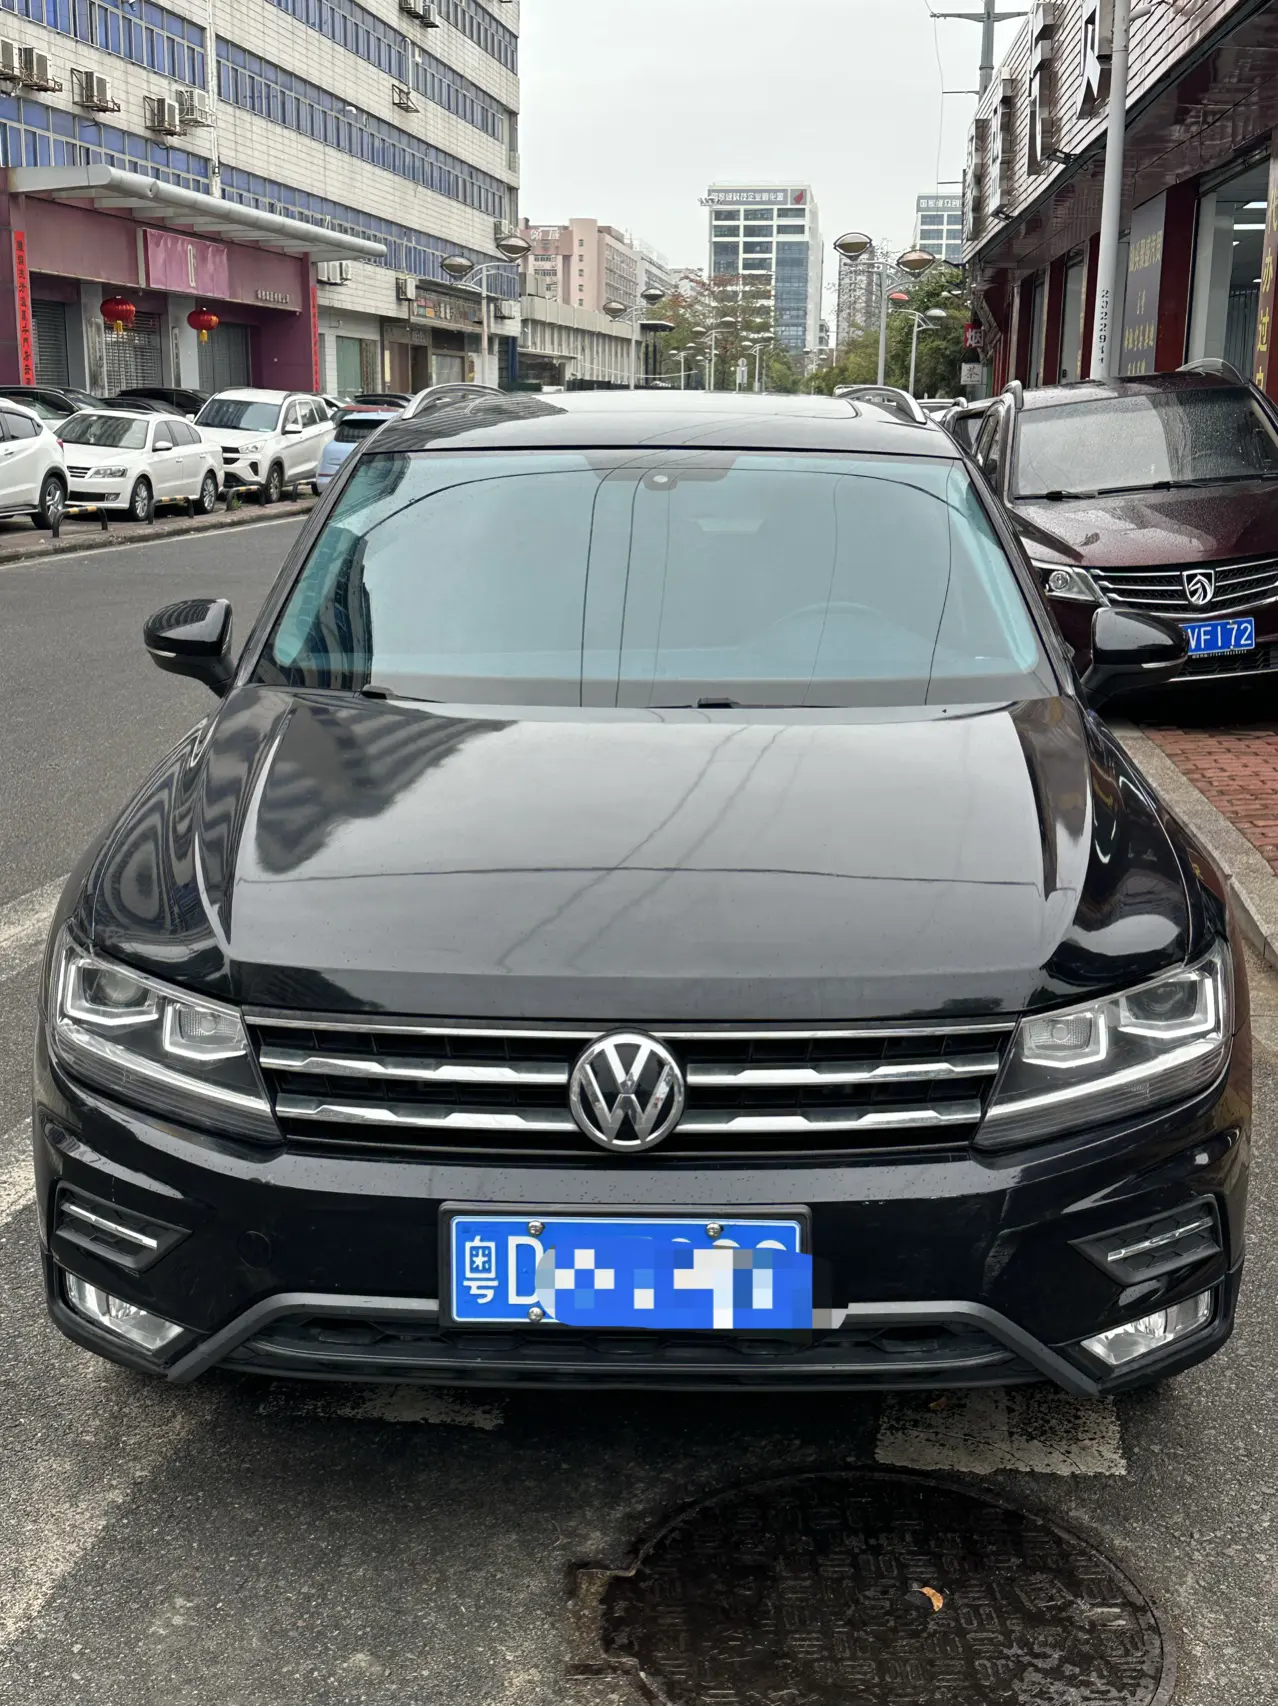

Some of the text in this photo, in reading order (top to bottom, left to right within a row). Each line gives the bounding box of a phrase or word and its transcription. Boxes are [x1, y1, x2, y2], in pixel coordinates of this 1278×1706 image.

[919, 199, 962, 208] 国家级众创
[966, 328, 984, 348] 烟
[1187, 622, 1252, 650] VF172
